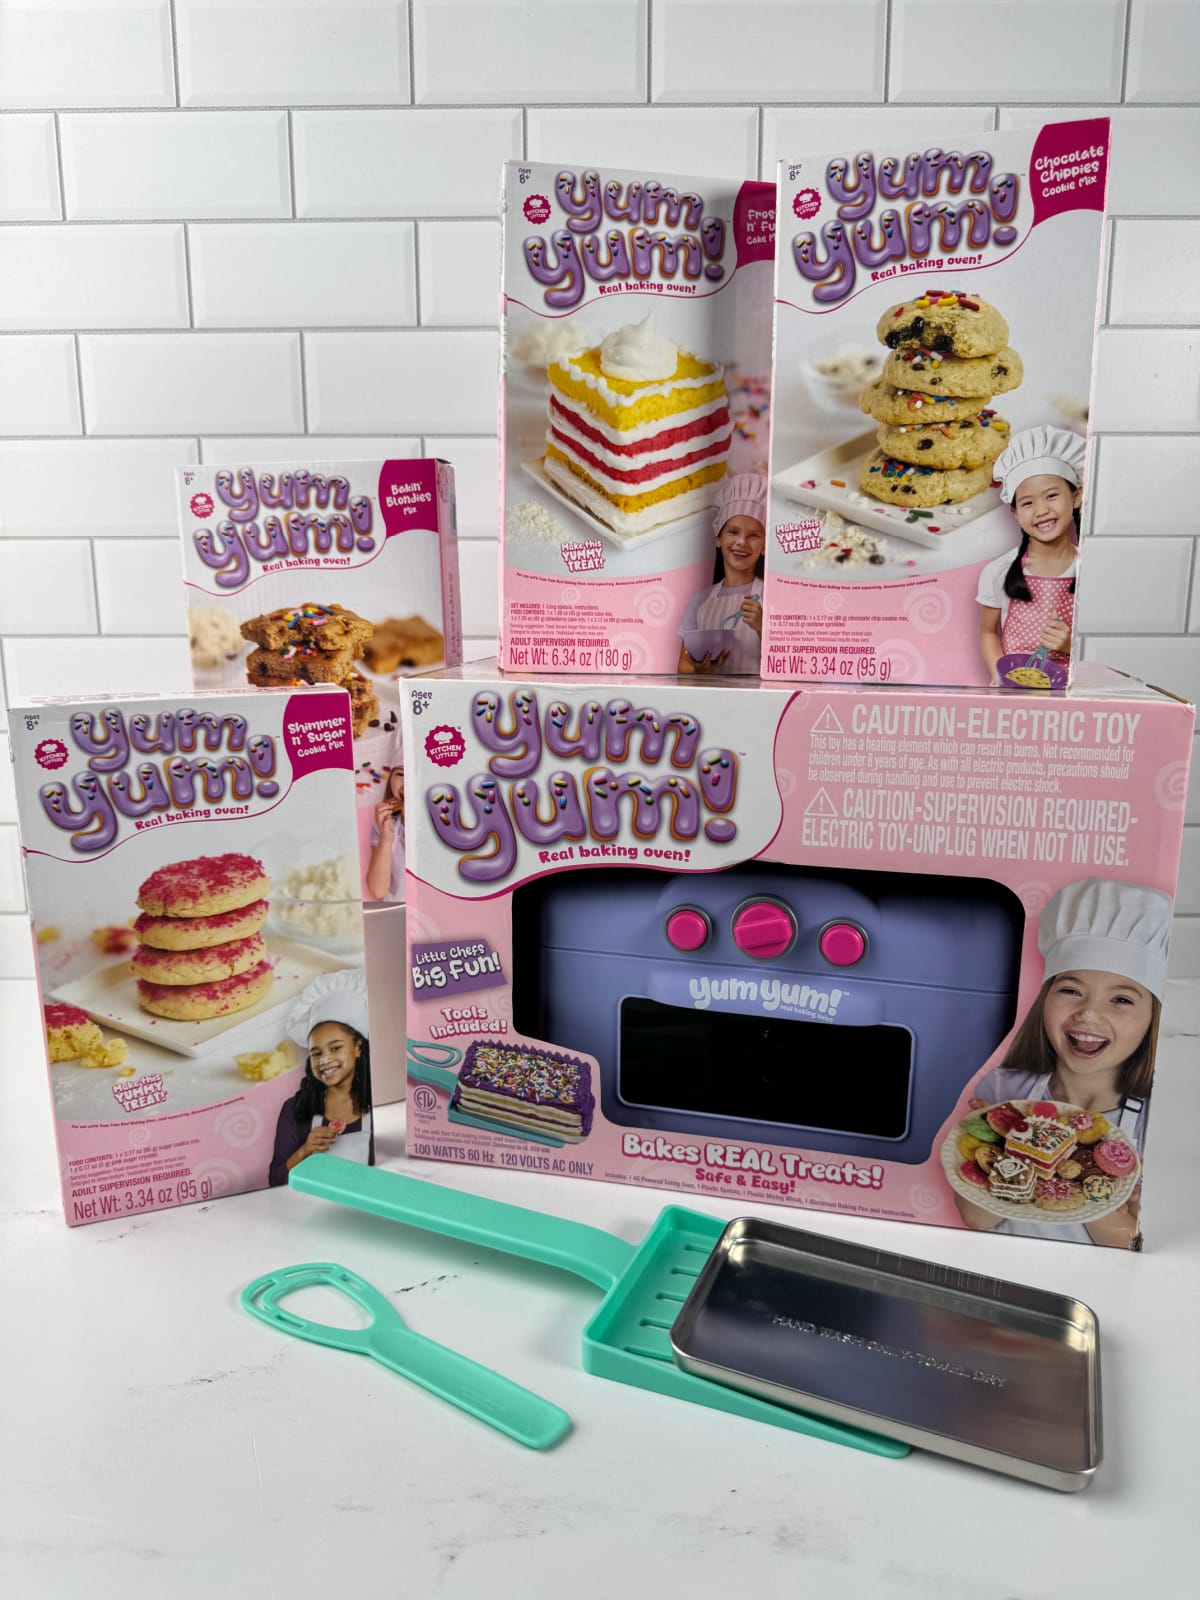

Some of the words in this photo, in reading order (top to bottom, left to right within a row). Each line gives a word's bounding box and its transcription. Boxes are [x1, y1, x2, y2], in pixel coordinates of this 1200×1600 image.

[1034, 145, 1105, 171] Chocolate
[789, 170, 801, 181] 8+
[1040, 161, 1100, 184] Chippies
[826, 149, 992, 221] yum
[1042, 183, 1076, 198] Cookie
[1078, 176, 1098, 187] Mix
[555, 170, 704, 234] yum
[748, 209, 776, 220] Fros
[760, 221, 776, 232] Fu
[746, 236, 767, 245] Cake
[792, 173, 1019, 303] yum!
[523, 216, 726, 308] yum!
[871, 266, 897, 281] Real
[900, 259, 944, 274] baking
[947, 254, 983, 266] oven!
[599, 283, 623, 295] Real
[625, 280, 664, 293] baking
[666, 284, 696, 294] oven!
[215, 467, 350, 522] yum
[386, 491, 432, 508] Blondies
[391, 481, 422, 496] Bakin'
[403, 507, 418, 516] Mix
[193, 495, 375, 588] yum!
[777, 528, 821, 543] YUMMY
[782, 538, 822, 554] TREAT!
[262, 560, 283, 573] Real
[286, 556, 320, 568] baking
[323, 557, 350, 566] oven!
[562, 547, 602, 563] YUMMY
[567, 558, 605, 572] TREAT!
[510, 637, 531, 646] ADULT
[533, 638, 576, 647] SUPERVISION
[769, 645, 790, 654] ADULT
[792, 646, 838, 654] SUPERVISION
[839, 646, 877, 655] REQUIRED.
[510, 647, 529, 666] Net
[531, 648, 549, 666] Wt:
[551, 648, 576, 666] 6.34
[579, 653, 592, 666] oz
[595, 649, 619, 669] (180
[622, 650, 632, 671] g)
[767, 655, 786, 674] Net
[789, 656, 807, 675] Wt:
[810, 656, 836, 676] 3.34
[839, 661, 854, 676] oz
[857, 657, 876, 680] (95
[880, 657, 891, 681] g)
[411, 690, 433, 701] Ages
[412, 699, 430, 716] 8+
[26, 720, 39, 731] 8+
[287, 715, 347, 735] Shimmer
[471, 688, 701, 779] yum
[851, 703, 1086, 743] CAUTION-ELECTRIC
[1092, 711, 1142, 745] TOY
[70, 707, 247, 773] yum
[290, 733, 303, 746] n'
[307, 728, 347, 745] Sugar
[297, 744, 327, 758] Cookie
[329, 738, 345, 749] Mix
[810, 734, 826, 749] This
[828, 735, 839, 752] toy
[842, 737, 857, 750] has
[866, 736, 896, 755] heating
[899, 738, 931, 754] element
[933, 739, 958, 755] which
[960, 742, 975, 755] can
[977, 741, 1001, 757] result
[1004, 741, 1012, 757] in
[1014, 743, 1040, 758] burns.
[1042, 743, 1057, 759] Not
[1059, 745, 1120, 762] recommended
[1122, 746, 1136, 762] for
[428, 744, 462, 756] KITCHEN
[809, 750, 841, 766] children
[843, 752, 866, 767] under
[875, 755, 897, 770] years
[899, 755, 907, 769] of
[909, 757, 926, 773] age.
[927, 755, 938, 770] As
[940, 755, 959, 772] with
[960, 757, 971, 772] all
[973, 758, 1005, 774] electric
[1006, 759, 1046, 778] products,
[1047, 761, 1098, 779] precautions
[1100, 763, 1130, 779] should
[808, 767, 818, 781] be
[820, 768, 856, 783] observed
[858, 769, 883, 787] during
[885, 770, 921, 789] handling
[922, 773, 938, 787] and
[940, 775, 955, 788] use
[957, 774, 965, 788] to
[967, 775, 999, 792] prevent
[1001, 776, 1033, 792] electric
[1034, 777, 1062, 793] shock.
[39, 735, 279, 853] yum!
[134, 815, 163, 831] Real
[165, 808, 211, 826] baking
[214, 804, 250, 816] oven!
[425, 748, 738, 882] yum!
[842, 788, 1038, 828] CAUTION-SUPERVISION
[1041, 798, 1139, 834] REQUIRED-
[801, 817, 873, 850] ELECTRIC
[878, 821, 976, 857] TOY-UNPLUG
[981, 829, 1028, 860] WHEN
[1033, 831, 1068, 863] NOT
[1072, 834, 1089, 865] IN
[1093, 836, 1130, 867] USE.
[538, 847, 574, 863] Real
[578, 844, 639, 861] baking
[643, 848, 691, 863] oven!
[416, 950, 447, 965] Little
[450, 943, 485, 959] Chefs
[412, 965, 447, 989] Big
[449, 952, 501, 981] Fun!
[441, 1005, 488, 1022] Tools
[430, 1019, 508, 1040] Included!
[114, 1082, 164, 1104] YUMMY
[122, 1090, 168, 1113] TREAT!
[414, 1142, 432, 1156] 100
[432, 1144, 465, 1159] WATTS
[467, 1147, 480, 1161] 60
[482, 1149, 495, 1163] Hz
[500, 1152, 518, 1166] 120
[519, 1154, 550, 1169] VOLTS
[552, 1159, 566, 1172] AC
[569, 1161, 594, 1176] ONLY
[622, 1132, 701, 1164] Bakes
[704, 1142, 778, 1176] REAL
[780, 1152, 884, 1190] Treats!
[72, 1186, 97, 1198] ADULT
[98, 1176, 151, 1192] SUPERVISION
[153, 1168, 193, 1182] REQUIRED.
[695, 1168, 732, 1185] Safe
[736, 1174, 747, 1186] &
[751, 1175, 796, 1195] Easy!
[73, 1198, 97, 1221] Net
[99, 1194, 122, 1217] Wt:
[125, 1187, 154, 1211] 3.34
[158, 1186, 174, 1203] oz
[176, 1179, 197, 1205] (95
[200, 1176, 213, 1201] g)
[773, 1313, 816, 1333] HAND
